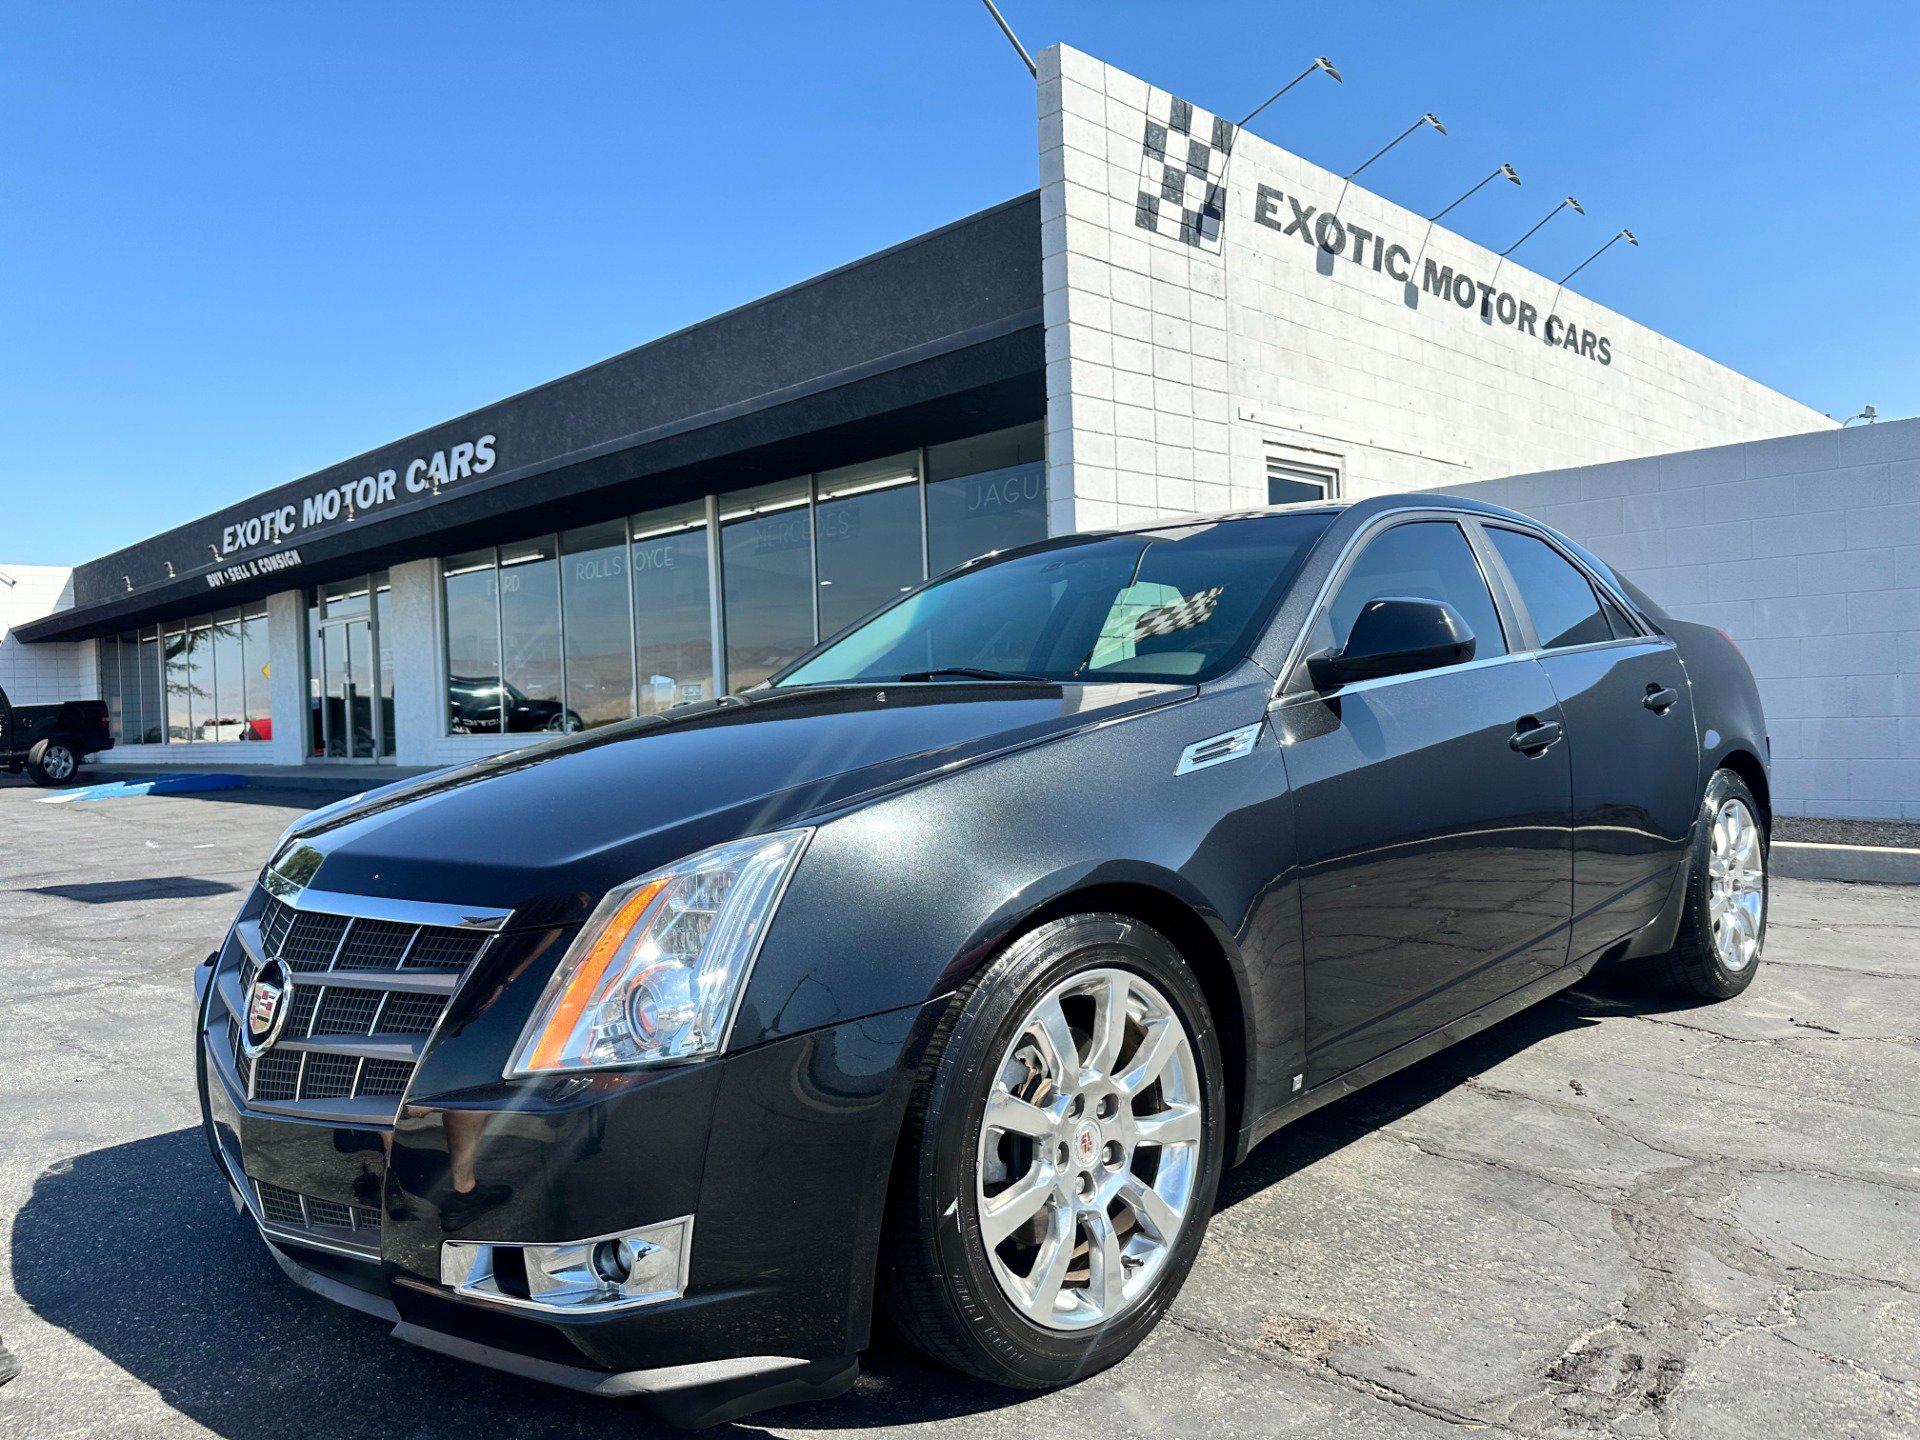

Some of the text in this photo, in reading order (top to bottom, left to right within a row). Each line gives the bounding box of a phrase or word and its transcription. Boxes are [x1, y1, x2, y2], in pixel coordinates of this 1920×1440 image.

[1254, 183, 1612, 366] EXOTIC MOTOR CARS
[222, 434, 496, 554] EXOTIC MOTOR CARS
[968, 474, 1044, 511] JAGU
[206, 549, 302, 588] BUY SELL & CONSIGN
[576, 546, 674, 581] ROLLS OYCE
